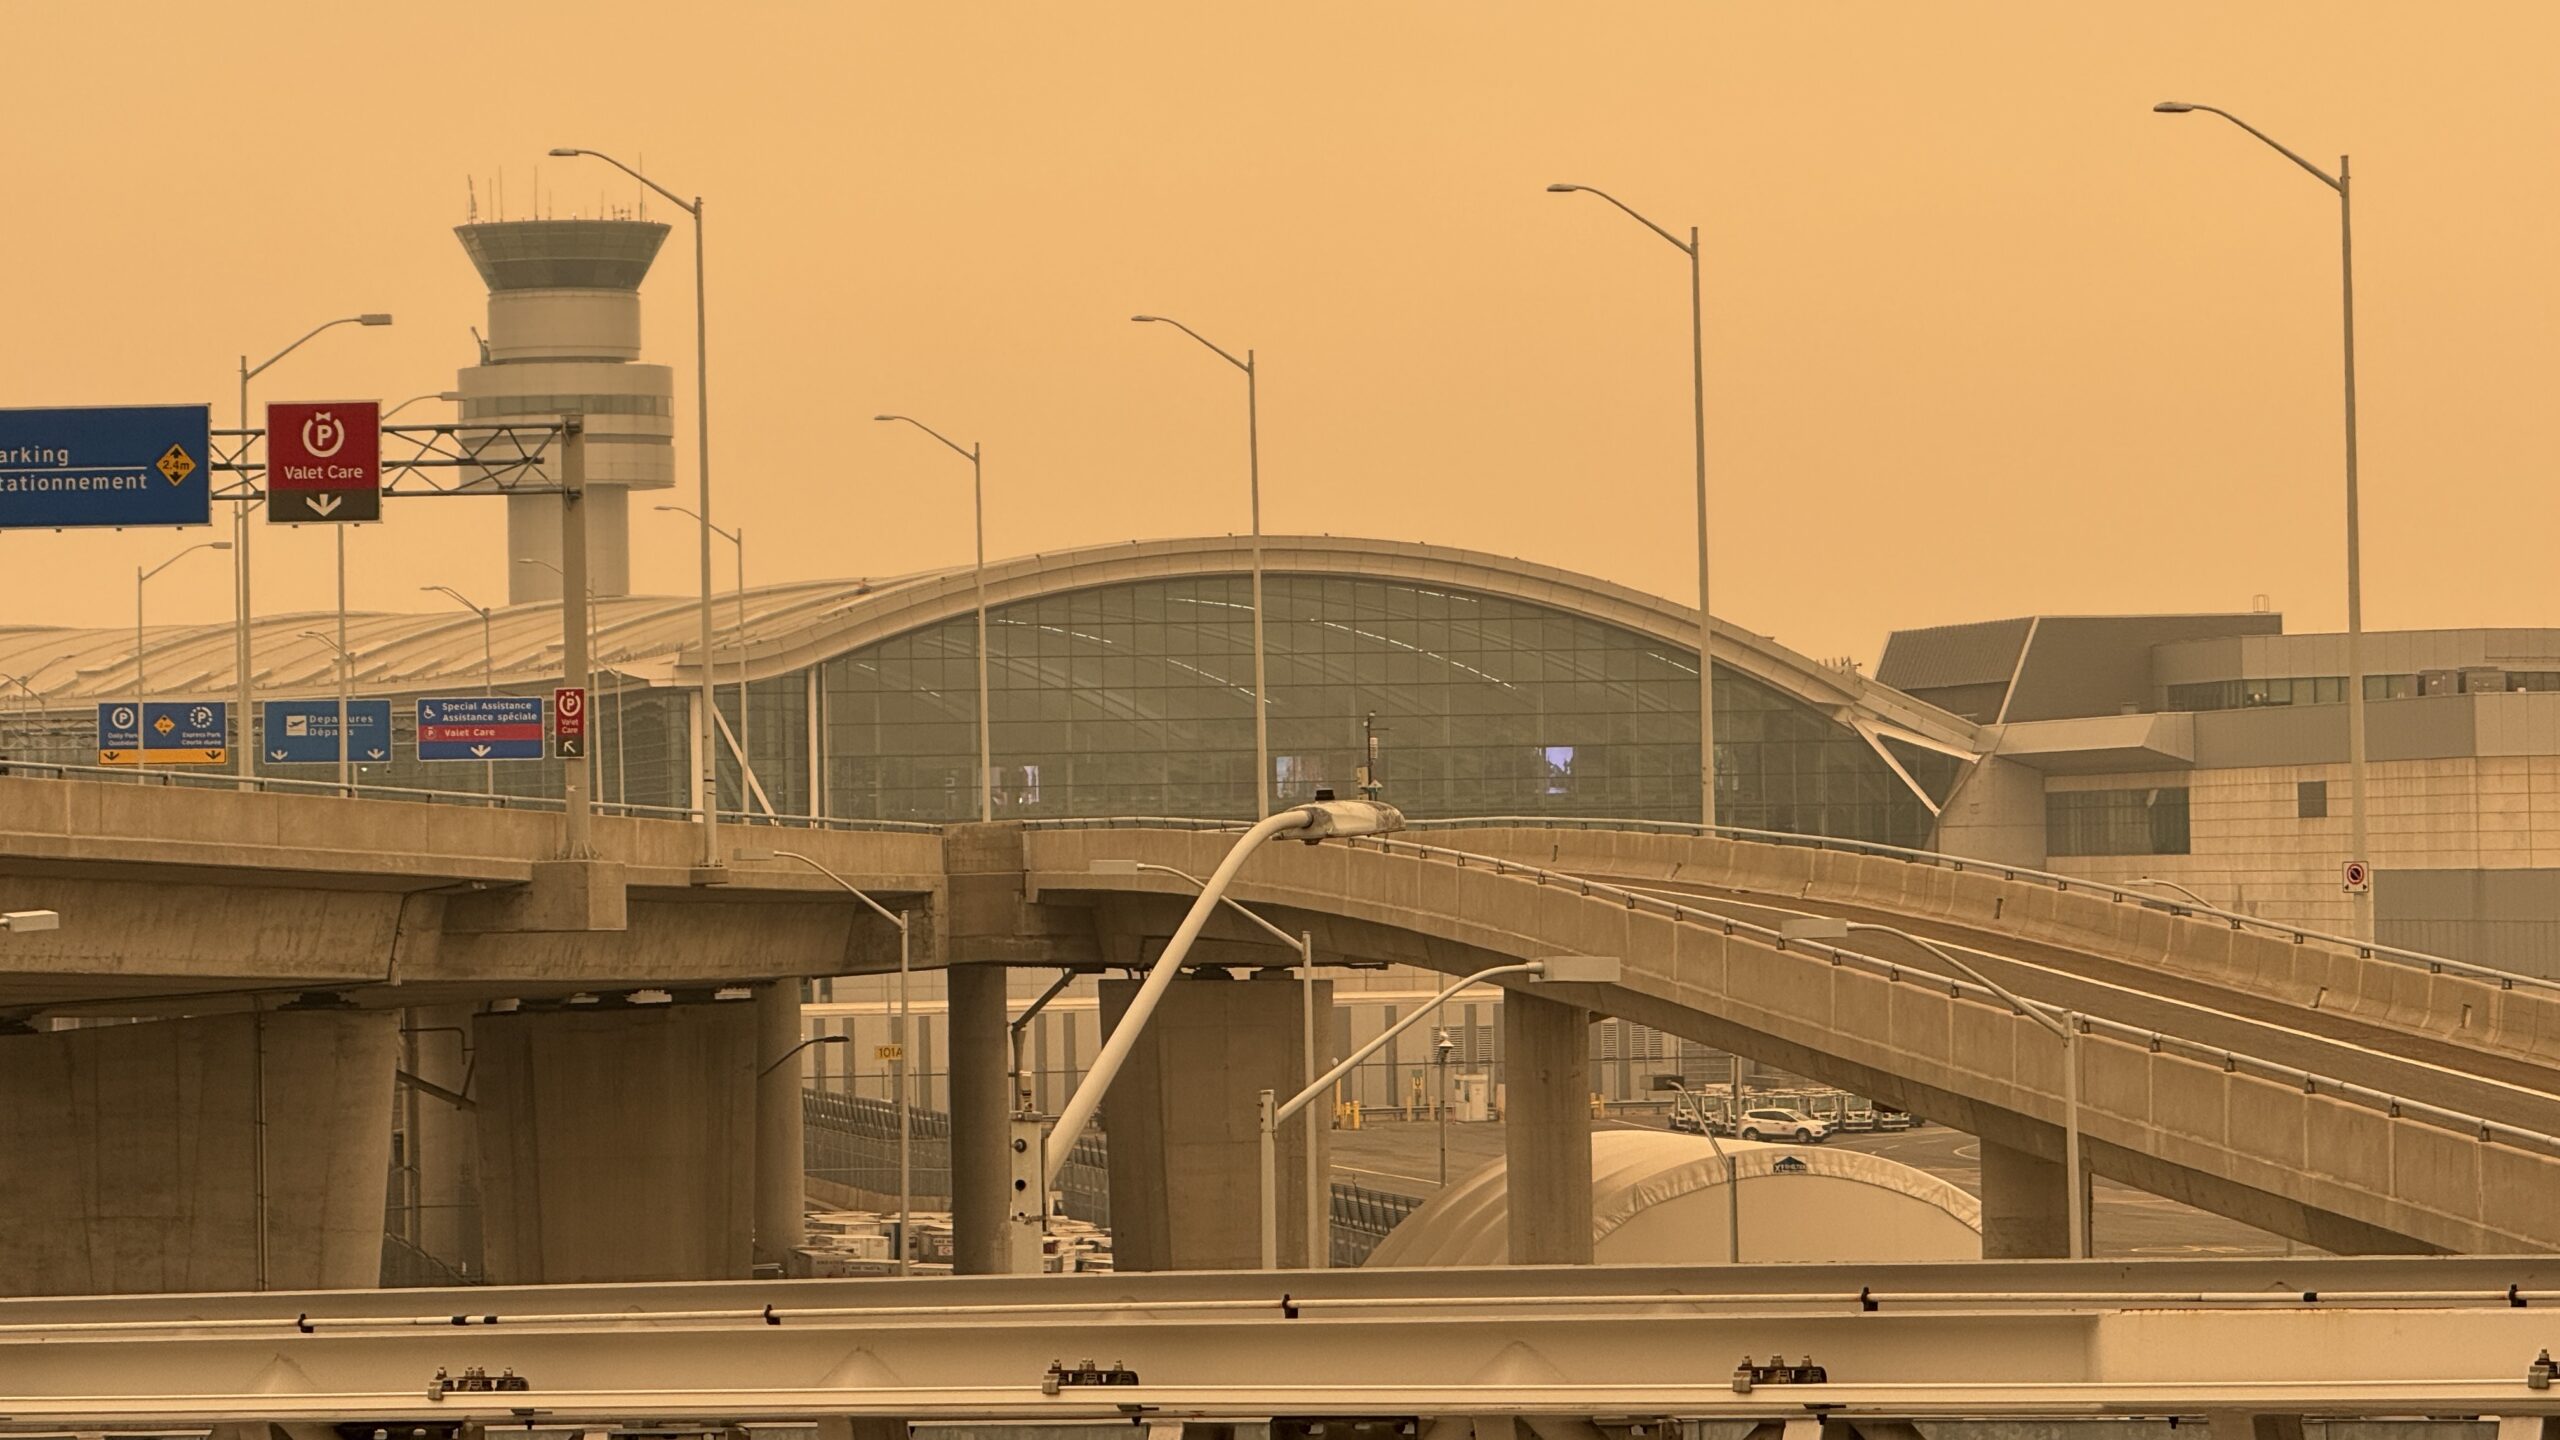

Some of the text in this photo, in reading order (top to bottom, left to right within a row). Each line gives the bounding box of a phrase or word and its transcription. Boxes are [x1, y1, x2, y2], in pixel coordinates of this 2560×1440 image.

[162, 460, 190, 470] 2.4m
[284, 465, 363, 480] Valet Care
[441, 702, 532, 712] Special Assistance
[309, 715, 374, 725] Depaures
[442, 711, 538, 722] Assistance spéciale
[561, 718, 579, 726] Valet
[309, 727, 355, 738] Dépas
[444, 728, 496, 737] Valet Care
[561, 726, 579, 734] Care
[879, 1047, 903, 1058] 101A
